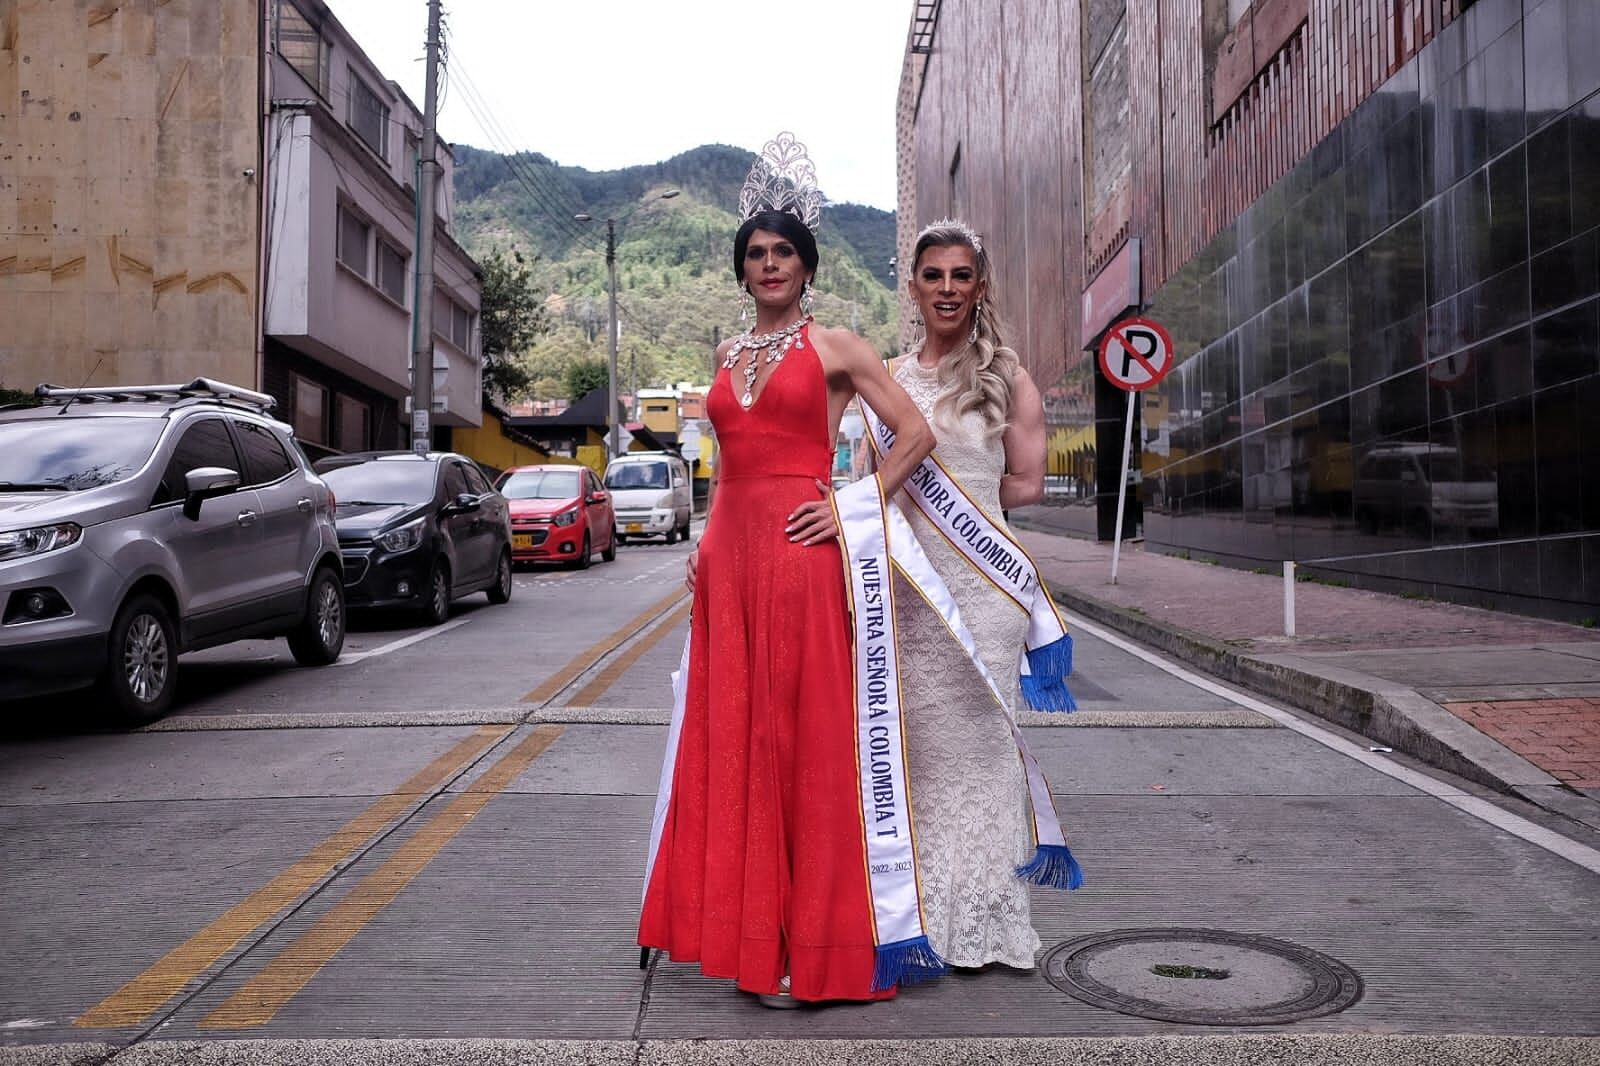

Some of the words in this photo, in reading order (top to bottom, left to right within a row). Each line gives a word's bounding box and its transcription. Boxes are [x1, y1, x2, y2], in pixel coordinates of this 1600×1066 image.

[1121, 330, 1158, 377] P
[909, 464, 956, 519] EÑORA
[952, 512, 1023, 585] COLOMBIA
[859, 557, 885, 641] NUESTRA
[866, 645, 889, 720] SEÑORA
[869, 726, 895, 823] COLOMBIA
[877, 826, 898, 838] T
